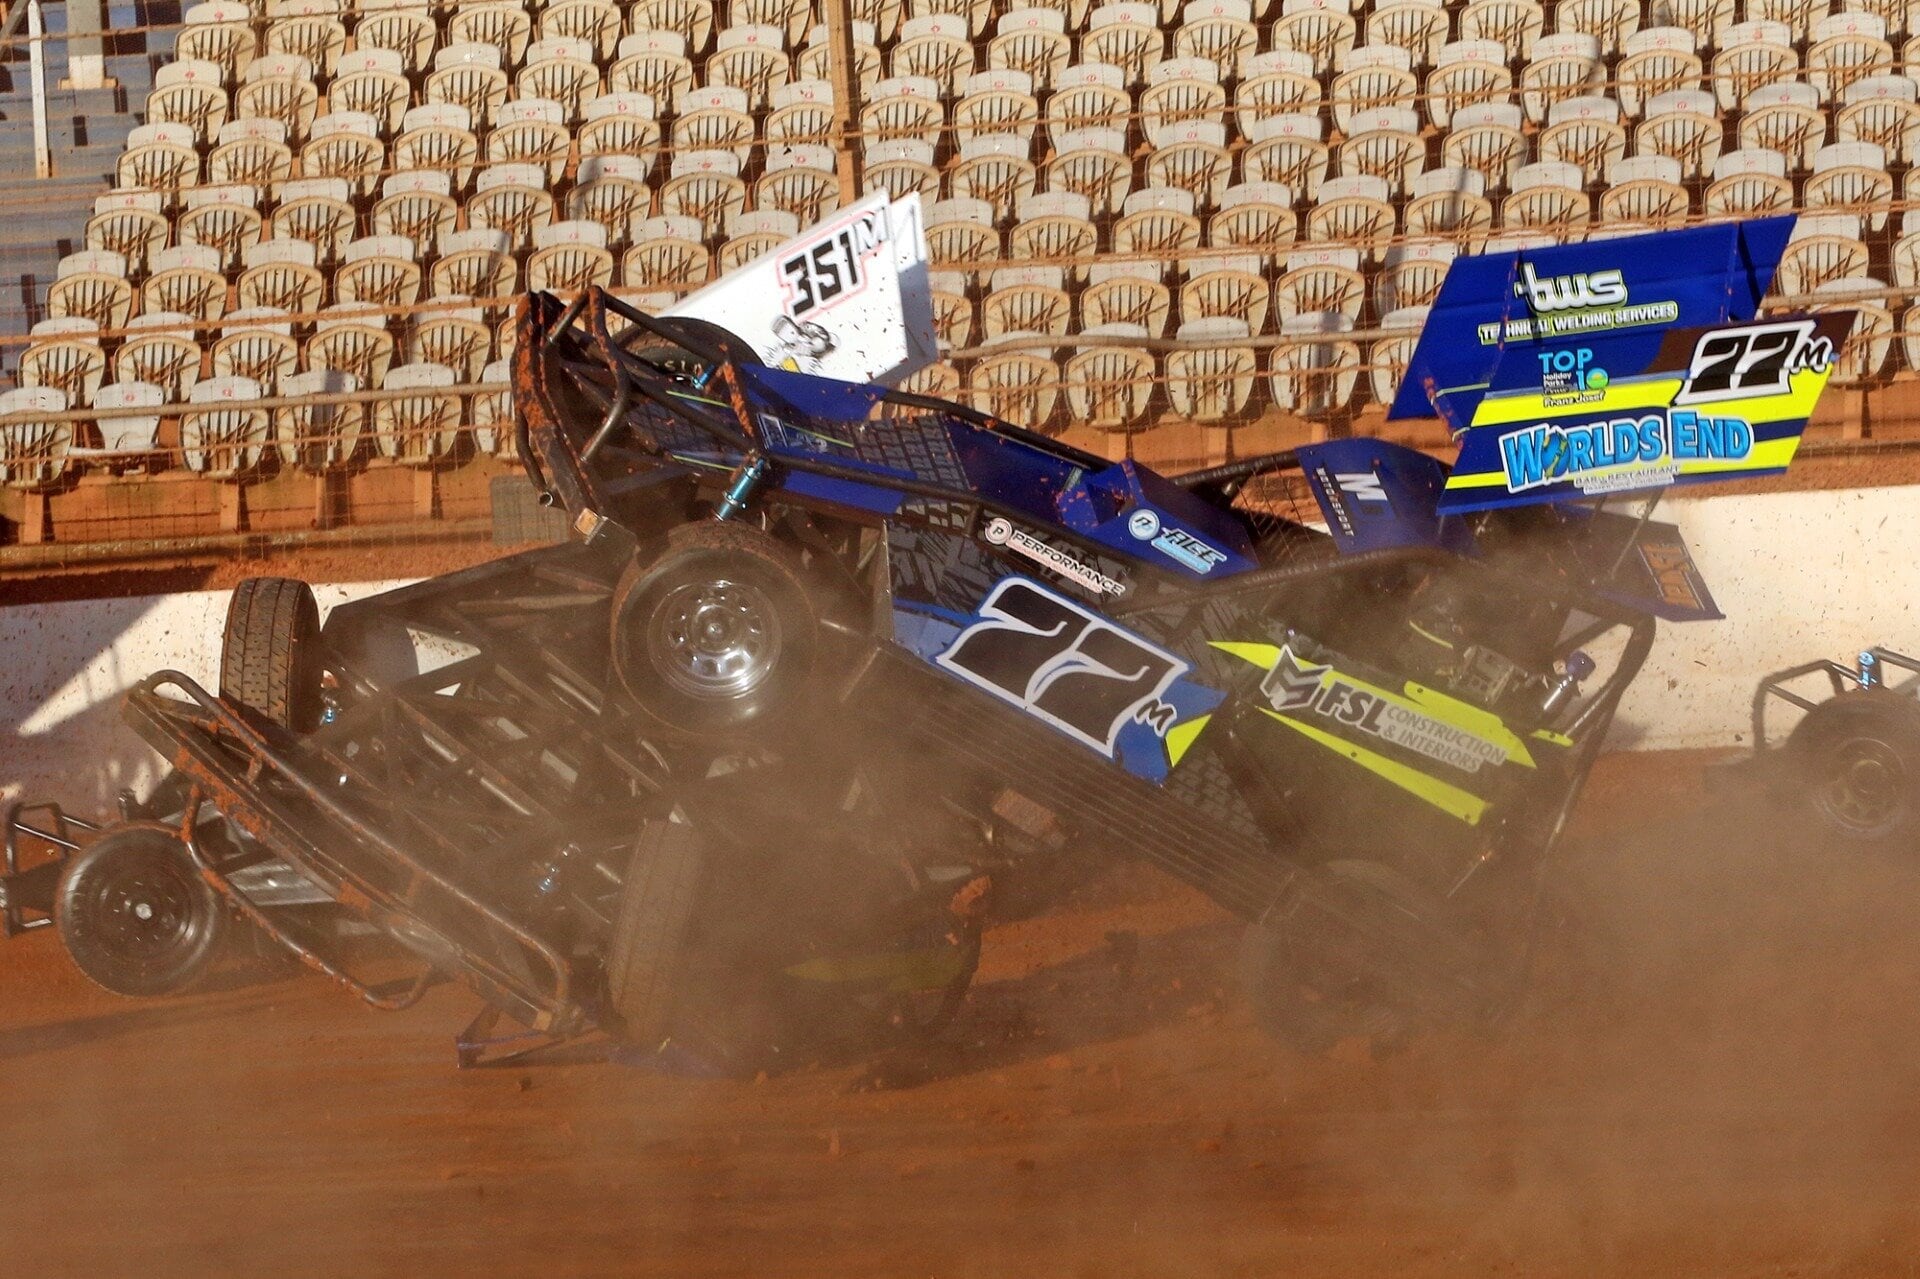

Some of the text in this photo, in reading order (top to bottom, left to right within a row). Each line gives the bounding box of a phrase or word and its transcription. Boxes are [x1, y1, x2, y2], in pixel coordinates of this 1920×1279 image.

[1555, 311, 1612, 331] WELDING
[1616, 304, 1675, 323] SERVICES
[1538, 348, 1593, 374] TOP
[1543, 372, 1572, 381] Holiday
[1544, 396, 1576, 408] Franz
[1575, 390, 1606, 404] Josef
[1671, 410, 1751, 459] END
[1608, 466, 1679, 480] RESTAURANT
[1012, 531, 1125, 595] PERFORMANCE
[1319, 681, 1387, 733] FSL
[1384, 725, 1481, 771] & INTERIORS
[1387, 705, 1507, 764] CONSTRUCTION
